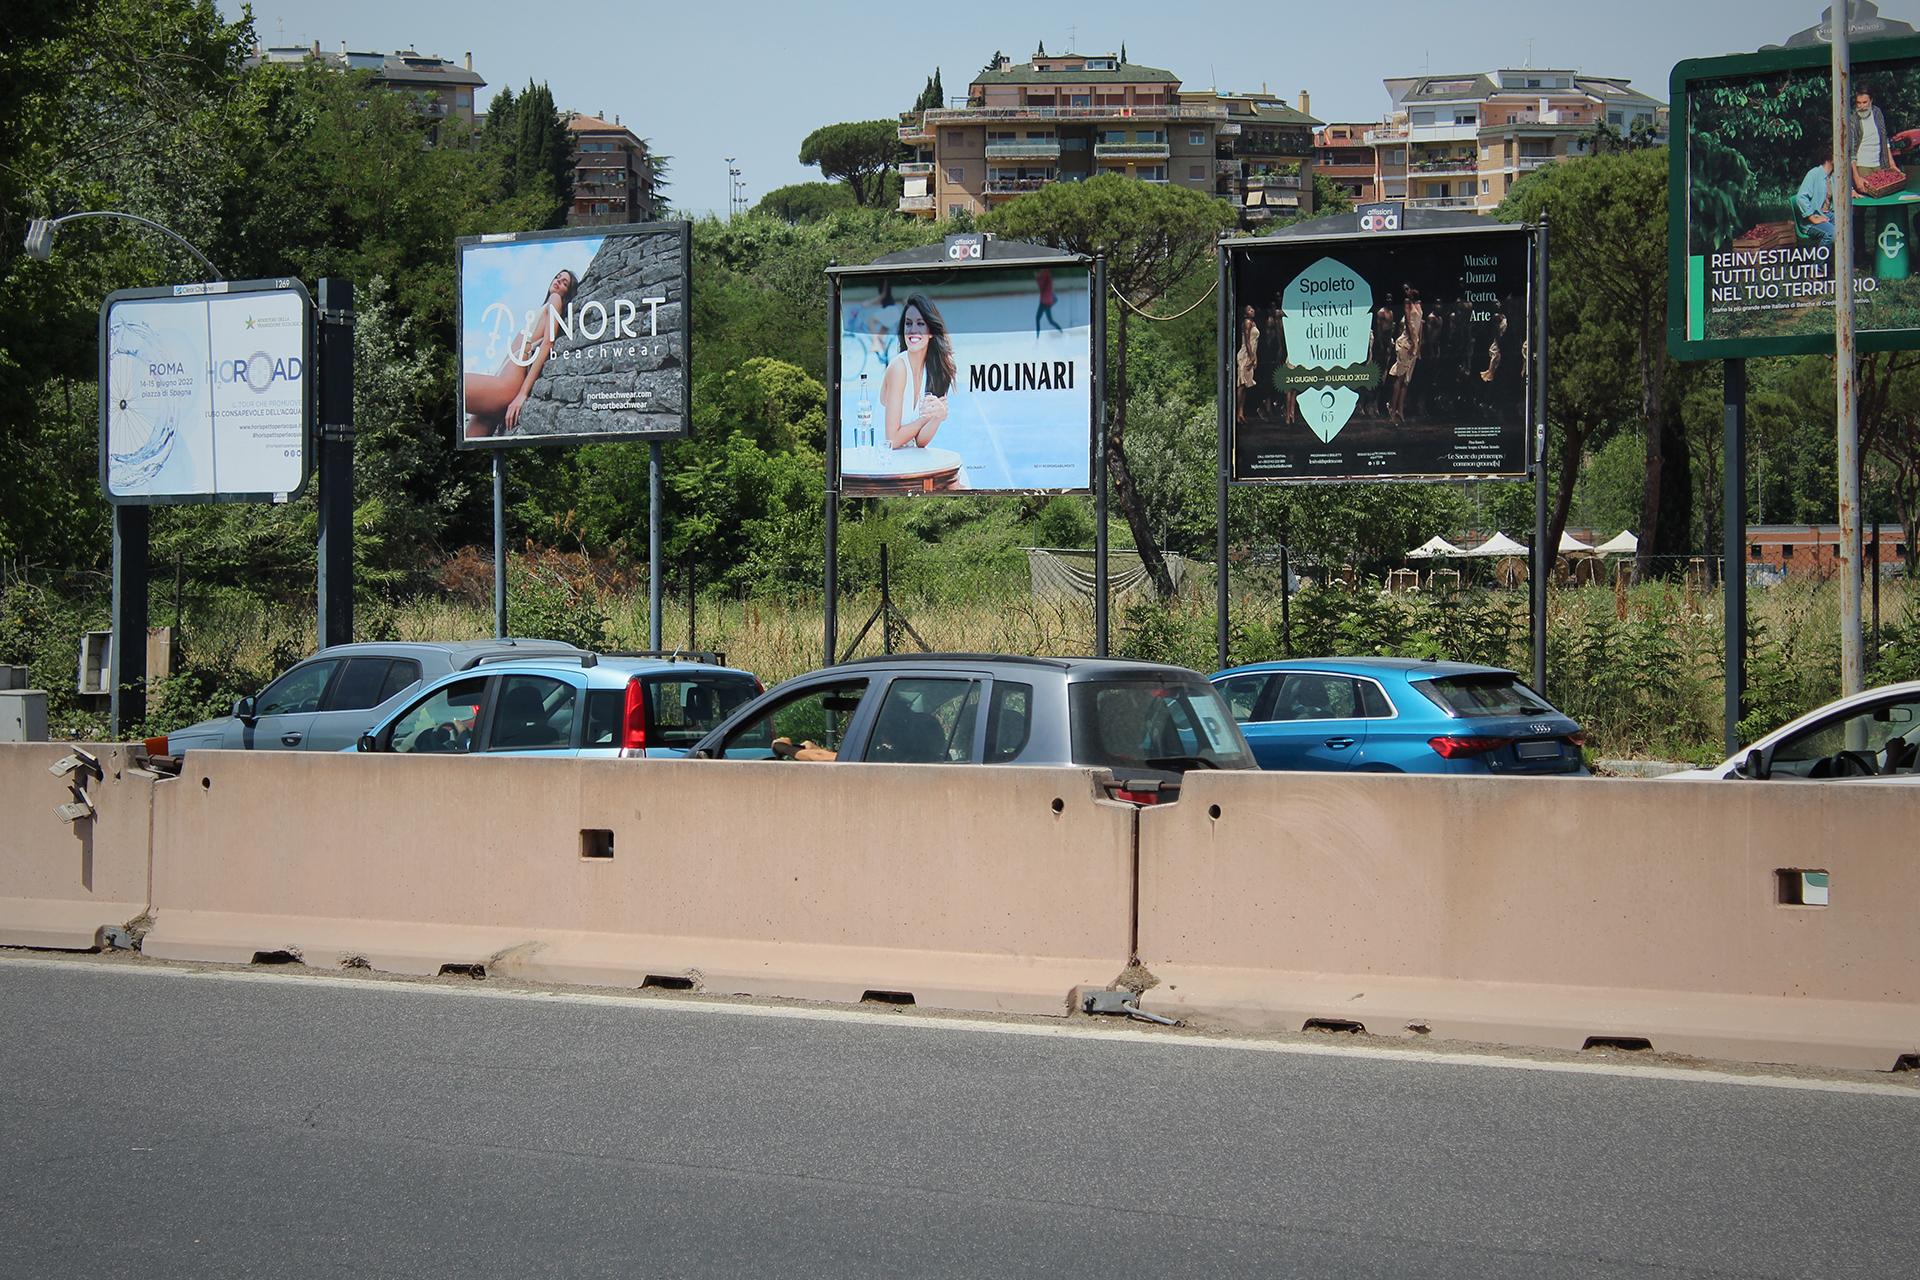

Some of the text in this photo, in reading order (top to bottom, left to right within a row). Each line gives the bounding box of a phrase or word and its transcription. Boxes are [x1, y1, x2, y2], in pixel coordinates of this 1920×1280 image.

[1361, 215, 1398, 232] apa
[949, 244, 981, 261] apa
[1464, 254, 1498, 267] Musica
[1712, 246, 1830, 268] REINVESTIAMO
[1466, 271, 1496, 283] Danza
[1712, 263, 1828, 285] TUTTI GLI UTILI
[275, 279, 290, 289] 1269
[1300, 277, 1355, 295] Spoleto
[1465, 290, 1497, 303] Teatro
[1712, 286, 1742, 302] NEL
[1745, 284, 1779, 299] TUO
[1302, 299, 1353, 318] Festival
[1470, 309, 1492, 322] Arte
[549, 296, 666, 343] NORT
[1306, 322, 1349, 340] dei Due
[550, 345, 659, 361] beachwear
[1310, 343, 1346, 360] Mondi
[149, 361, 185, 377] ROMA
[970, 361, 1074, 392] MOLINARI
[156, 379, 178, 389] giugno
[178, 377, 194, 386] 2022
[1294, 375, 1318, 384] GIUGNO
[1332, 374, 1354, 382] LUGLIO
[1354, 373, 1370, 381] 2022
[141, 390, 161, 399] piazza
[587, 391, 652, 401] nortbeachwear.com
[221, 408, 265, 417] CONSAPEVOLE
[591, 401, 648, 411] @nortbeachwear
[1321, 410, 1335, 423] 65
